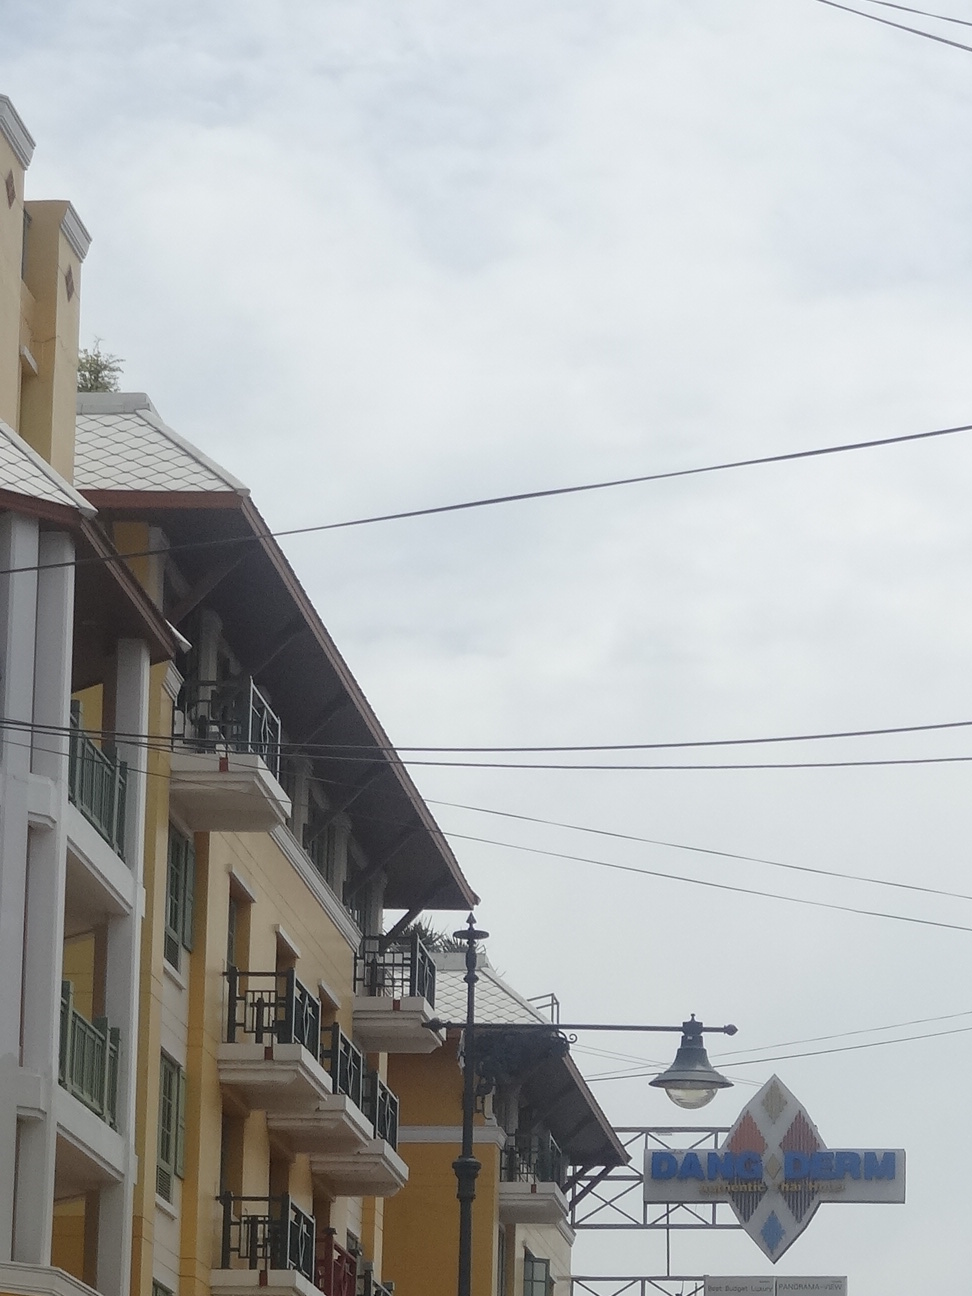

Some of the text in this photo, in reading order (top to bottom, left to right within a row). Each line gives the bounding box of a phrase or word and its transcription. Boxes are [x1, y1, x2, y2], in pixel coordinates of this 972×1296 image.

[651, 1151, 896, 1181] DANG DERM
[708, 1285, 723, 1293] Best
[724, 1285, 748, 1294] Budget
